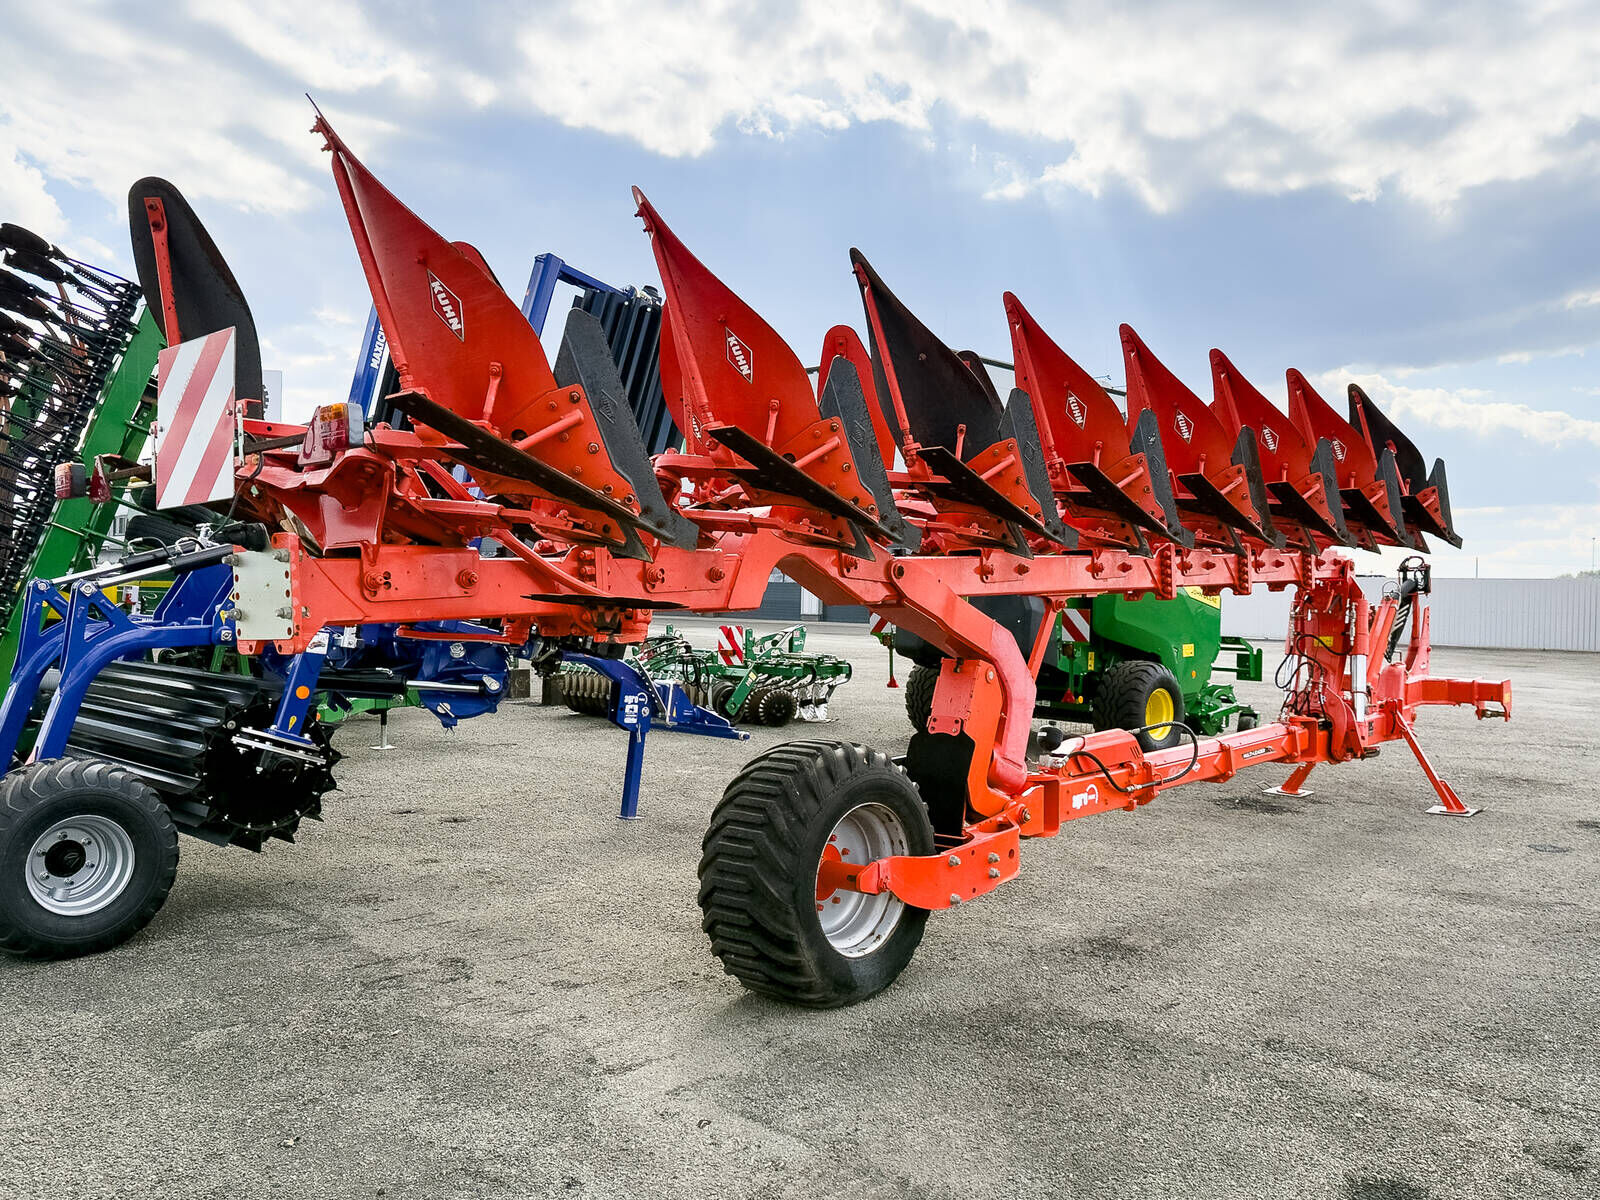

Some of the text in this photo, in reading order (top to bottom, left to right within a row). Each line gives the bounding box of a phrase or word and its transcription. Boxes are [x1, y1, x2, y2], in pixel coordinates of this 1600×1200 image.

[430, 281, 462, 330] KUHN
[728, 336, 751, 375] KUHN
[1068, 396, 1083, 424] KUHN
[1177, 415, 1190, 438] KUHN
[1263, 429, 1276, 450] KUHN
[1332, 440, 1344, 460] KUHN
